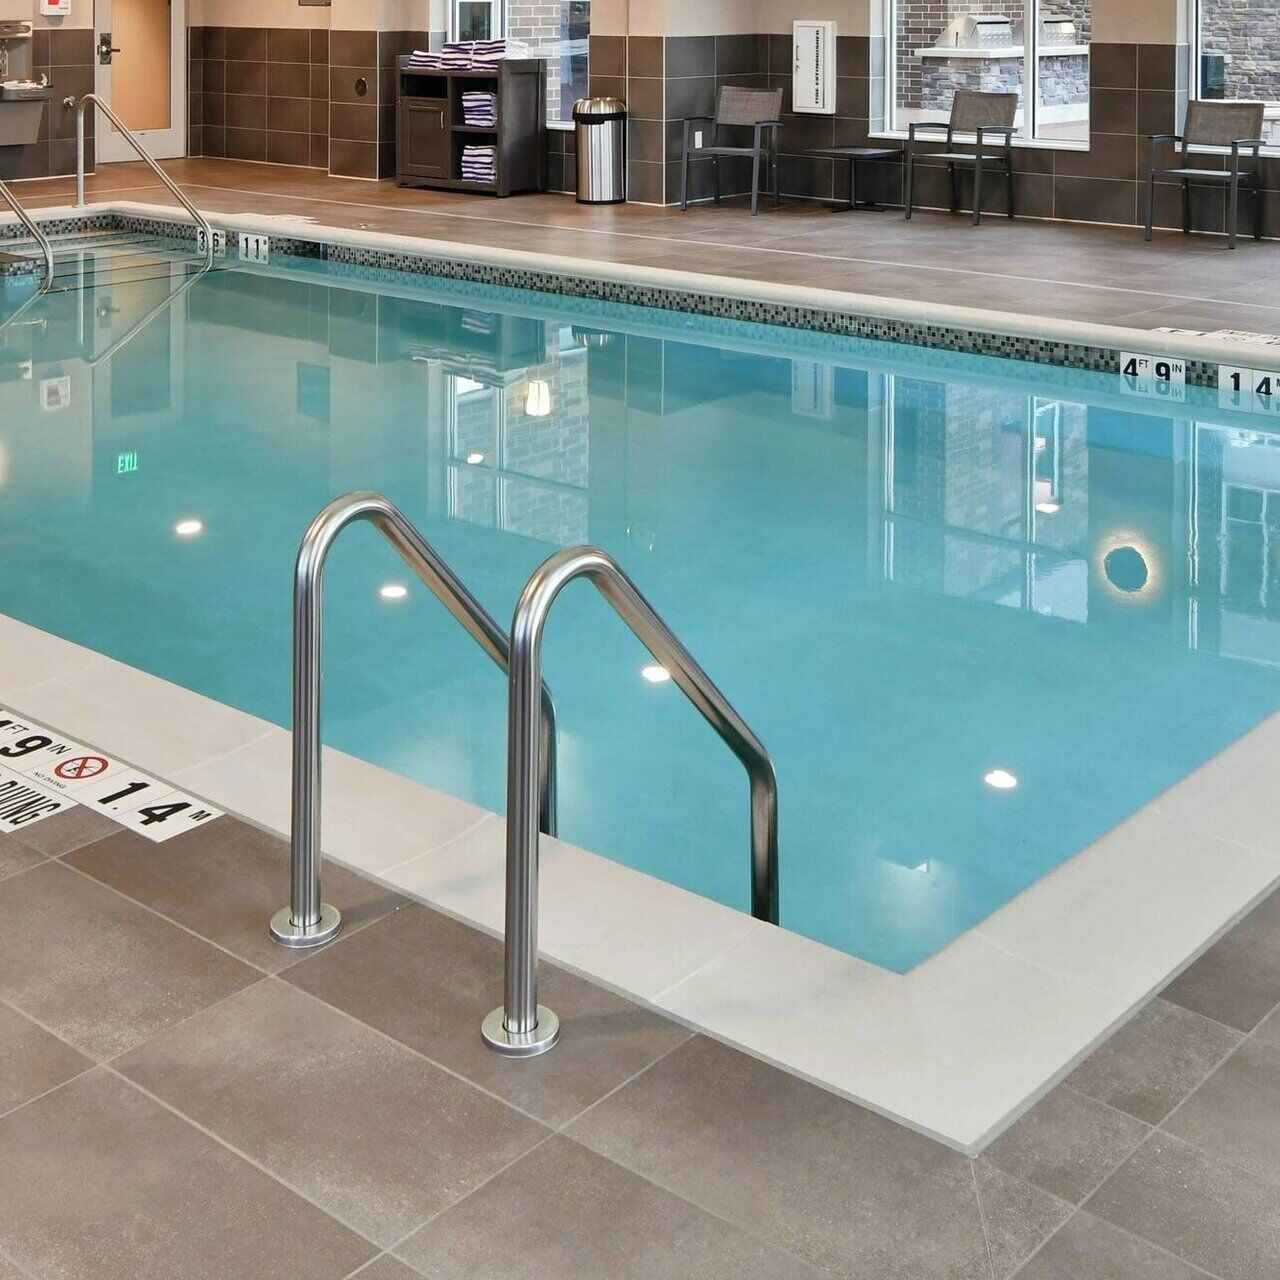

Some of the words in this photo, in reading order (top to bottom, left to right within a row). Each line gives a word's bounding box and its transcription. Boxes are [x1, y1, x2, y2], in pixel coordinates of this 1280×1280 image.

[1123, 358, 1139, 377] 4
[1139, 359, 1149, 368] FT
[1155, 361, 1170, 382] 9
[1172, 363, 1182, 373] IN
[4, 724, 29, 734] FT
[46, 743, 72, 755] IN
[188, 810, 212, 821] M
